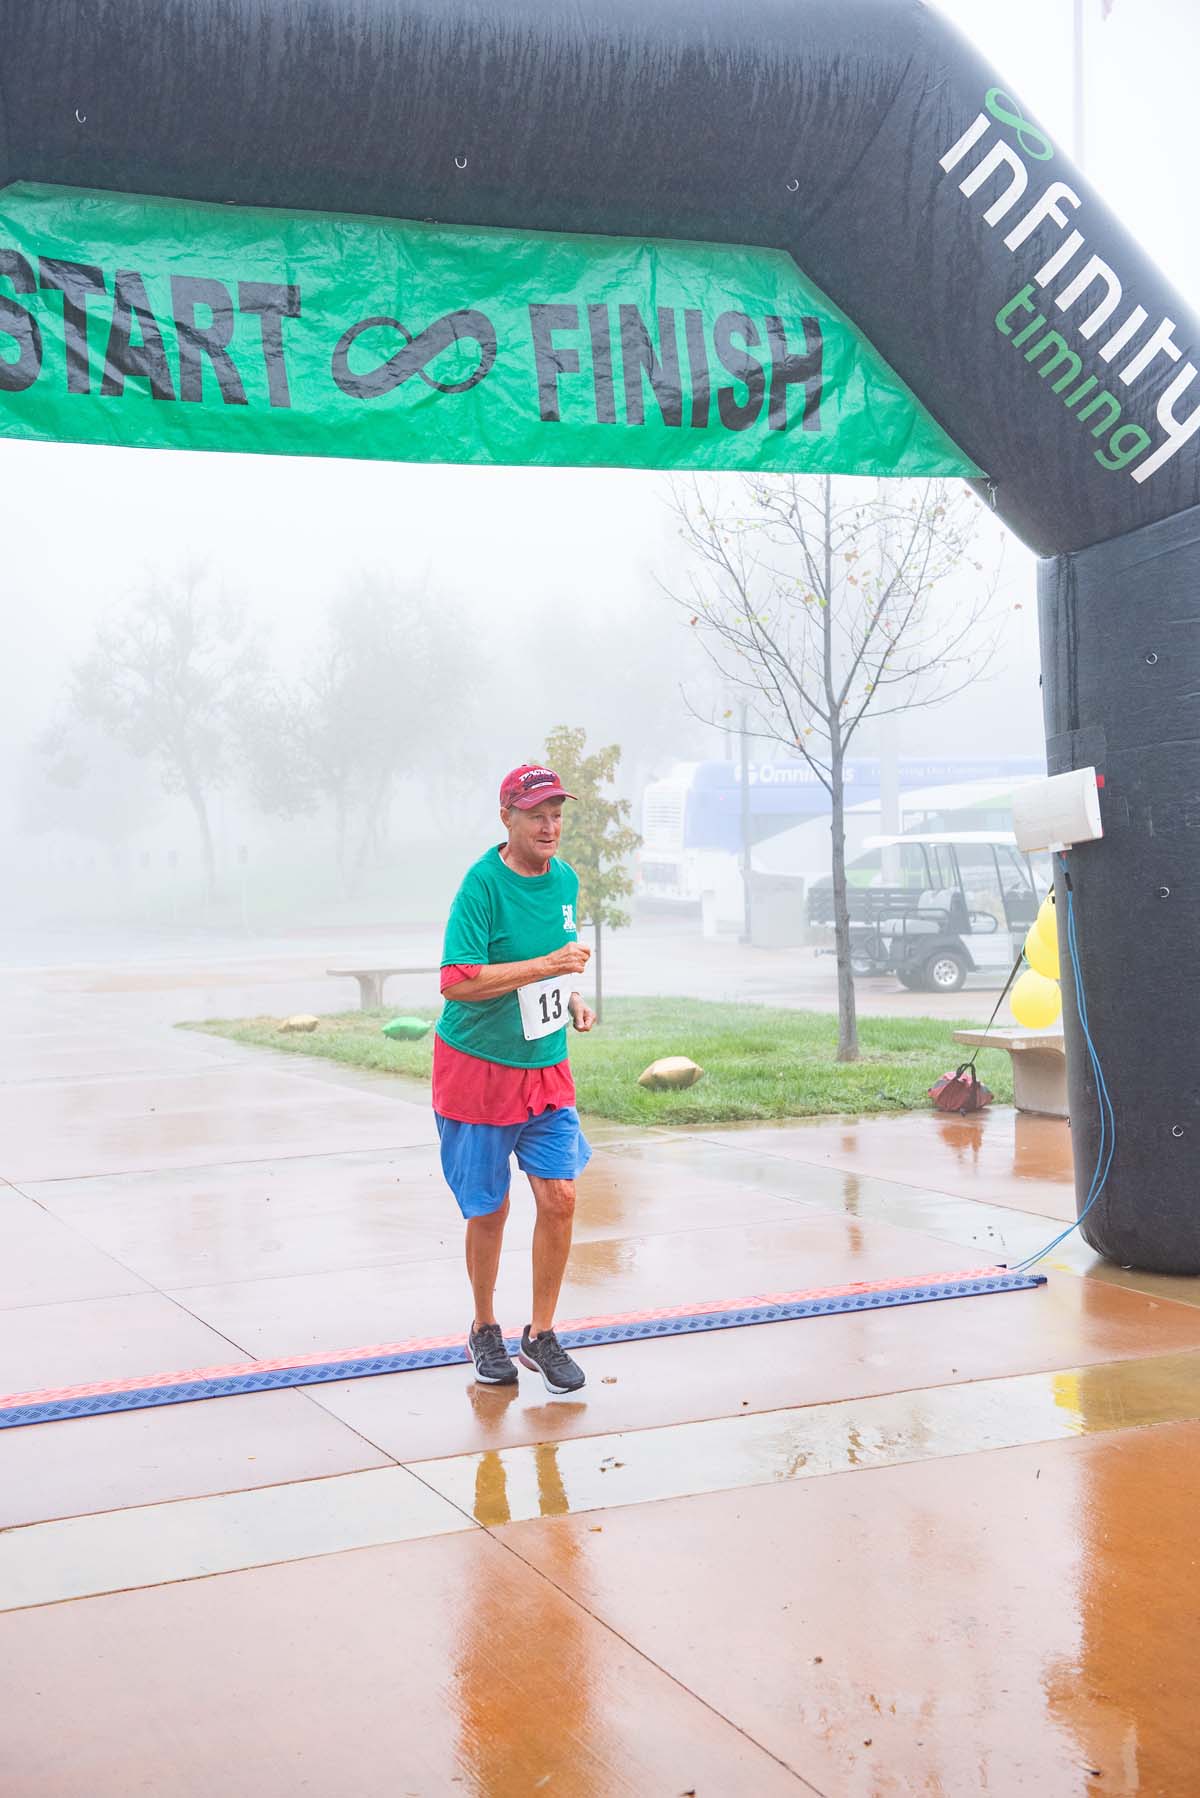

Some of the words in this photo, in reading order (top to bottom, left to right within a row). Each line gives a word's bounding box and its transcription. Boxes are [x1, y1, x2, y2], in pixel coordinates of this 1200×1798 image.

[0, 248, 301, 409] START
[528, 302, 825, 432] FINISH
[994, 283, 1152, 472] timing
[539, 988, 562, 1024] 13
